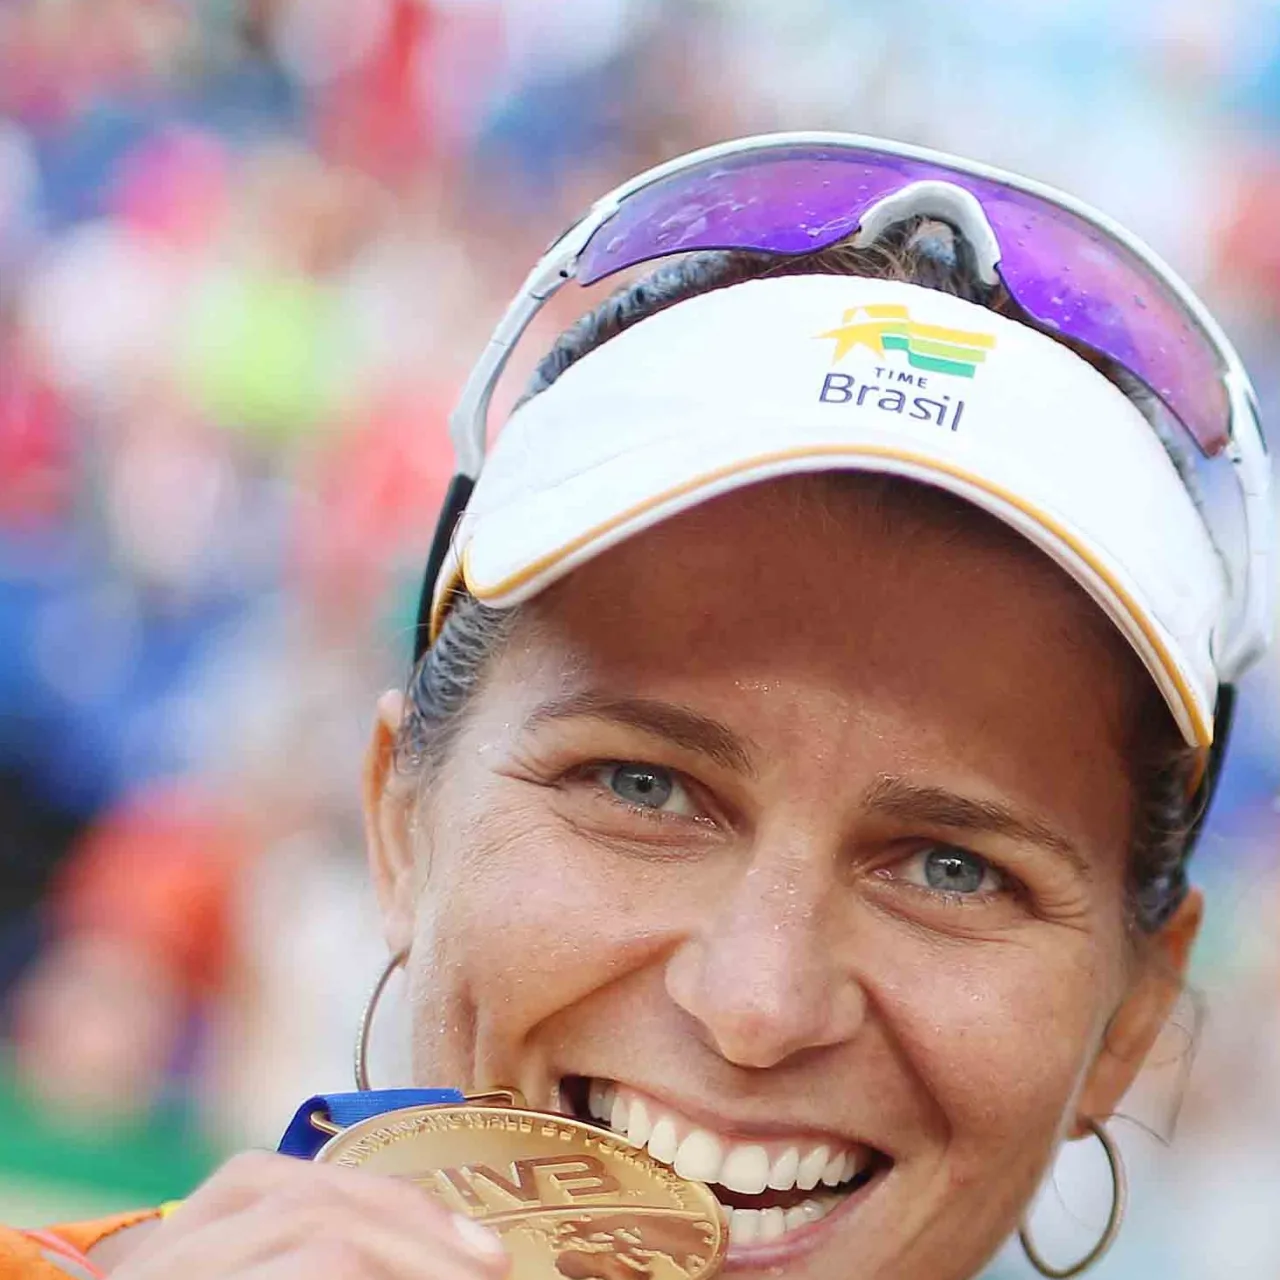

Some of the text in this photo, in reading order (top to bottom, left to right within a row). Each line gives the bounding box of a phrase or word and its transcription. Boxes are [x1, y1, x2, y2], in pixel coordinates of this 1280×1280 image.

[818, 372, 966, 432] Brasil
[874, 366, 928, 389] TIME
[408, 1154, 622, 1218] IVB
